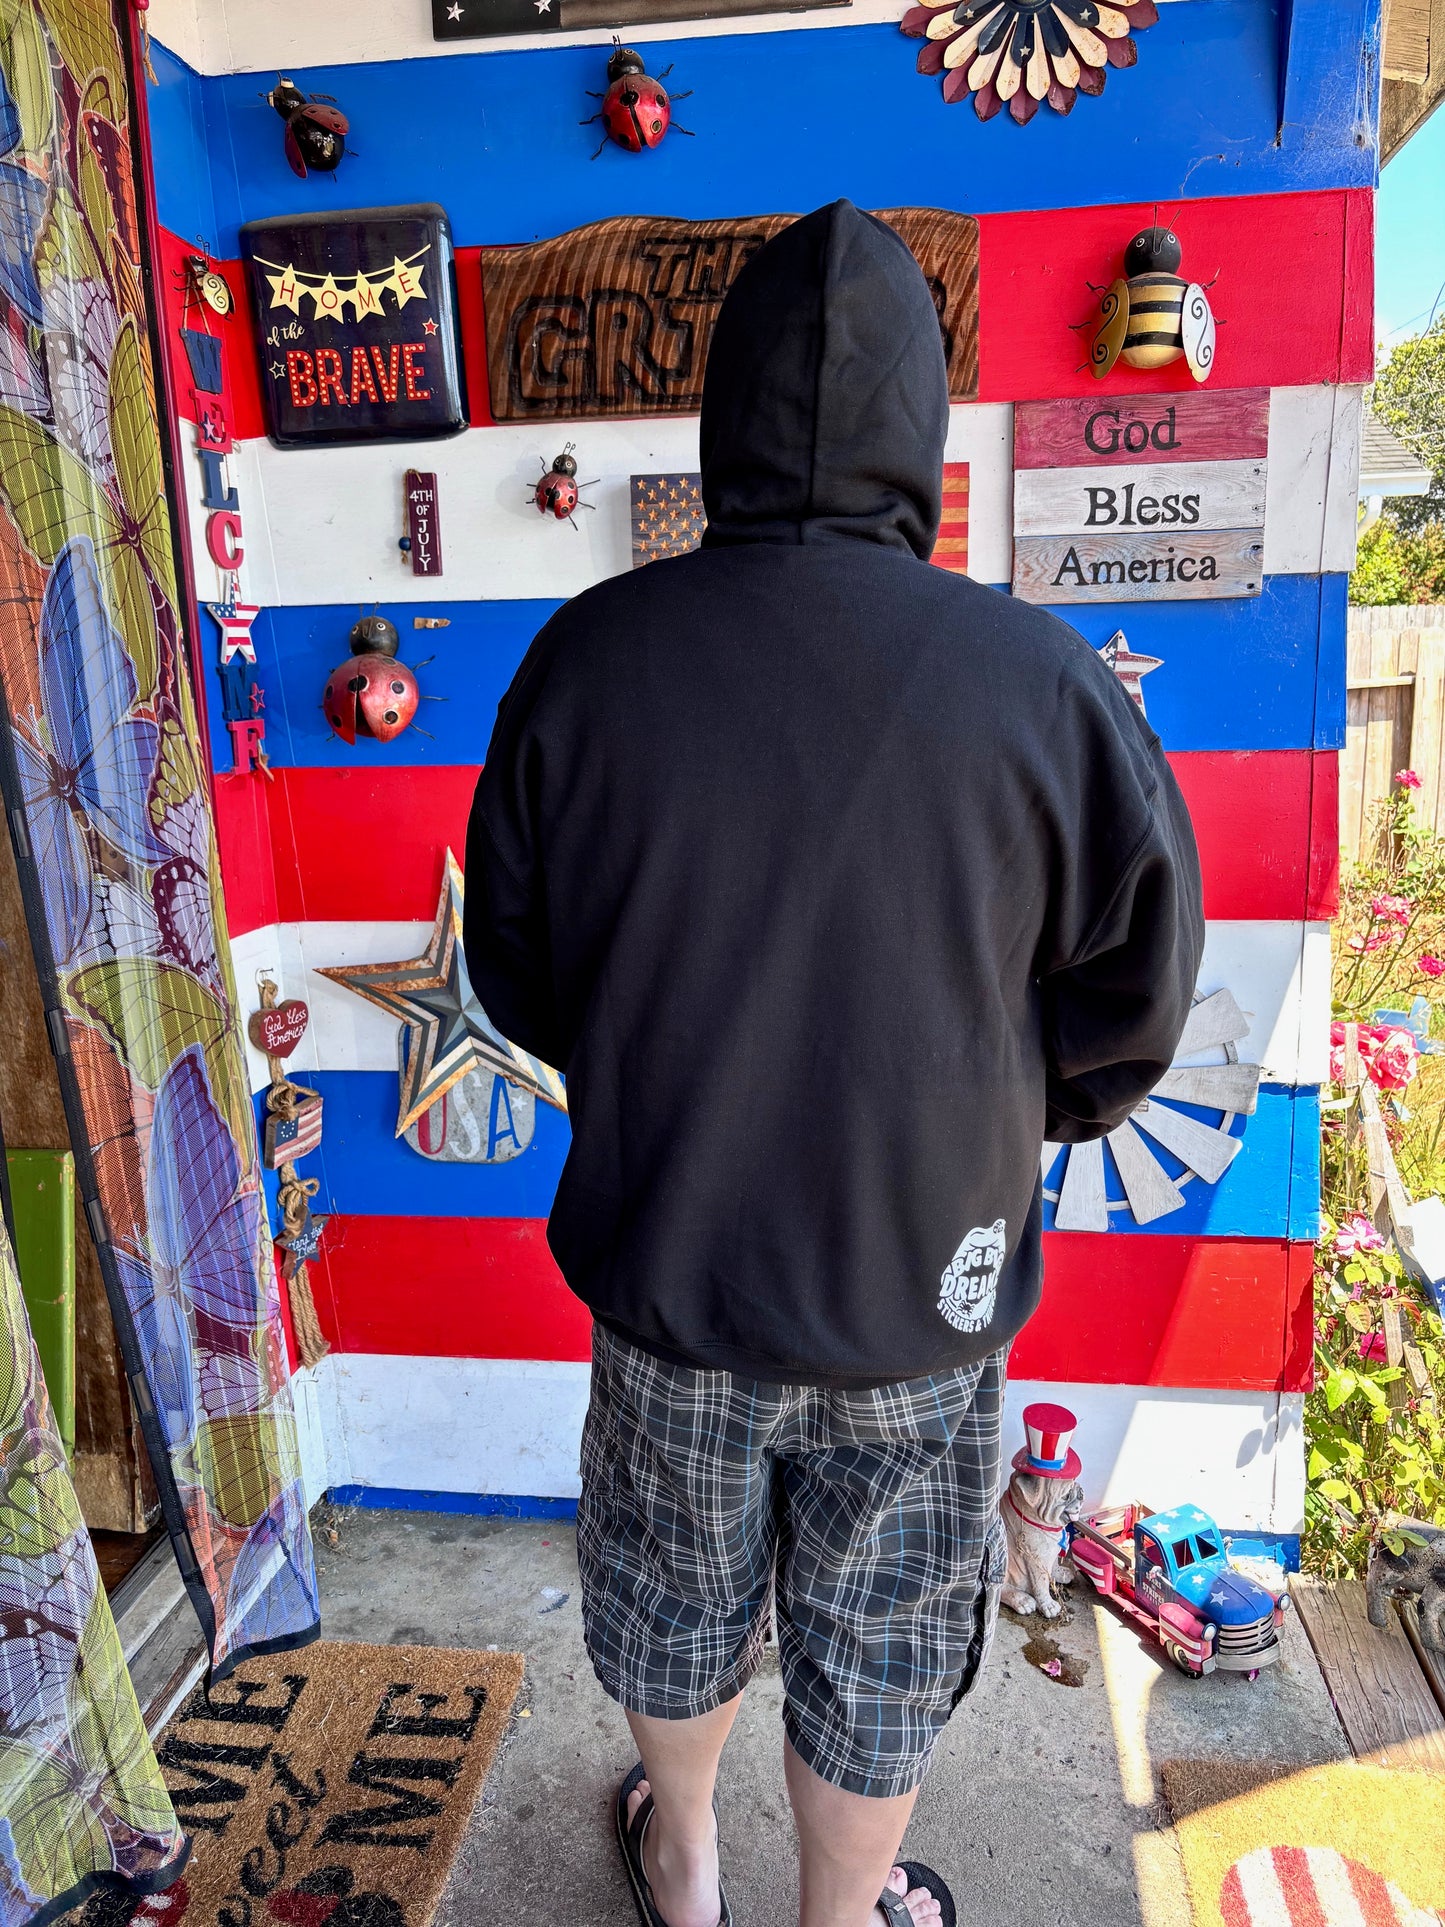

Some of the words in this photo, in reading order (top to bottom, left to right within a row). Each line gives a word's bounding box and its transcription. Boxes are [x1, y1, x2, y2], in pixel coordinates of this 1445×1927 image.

[279, 271, 415, 311] HOME
[266, 325, 281, 348] of
[280, 320, 306, 341] the
[286, 343, 431, 408] BRAVE
[1083, 406, 1182, 455] God
[409, 489, 434, 502] 4TH
[415, 504, 430, 516] OF
[1083, 482, 1200, 526] Bless
[417, 519, 432, 572] JULY
[1049, 546, 1221, 587] America
[417, 1070, 522, 1160] USA
[951, 1247, 983, 1278] BIG
[937, 1298, 974, 1334] STICKERS
